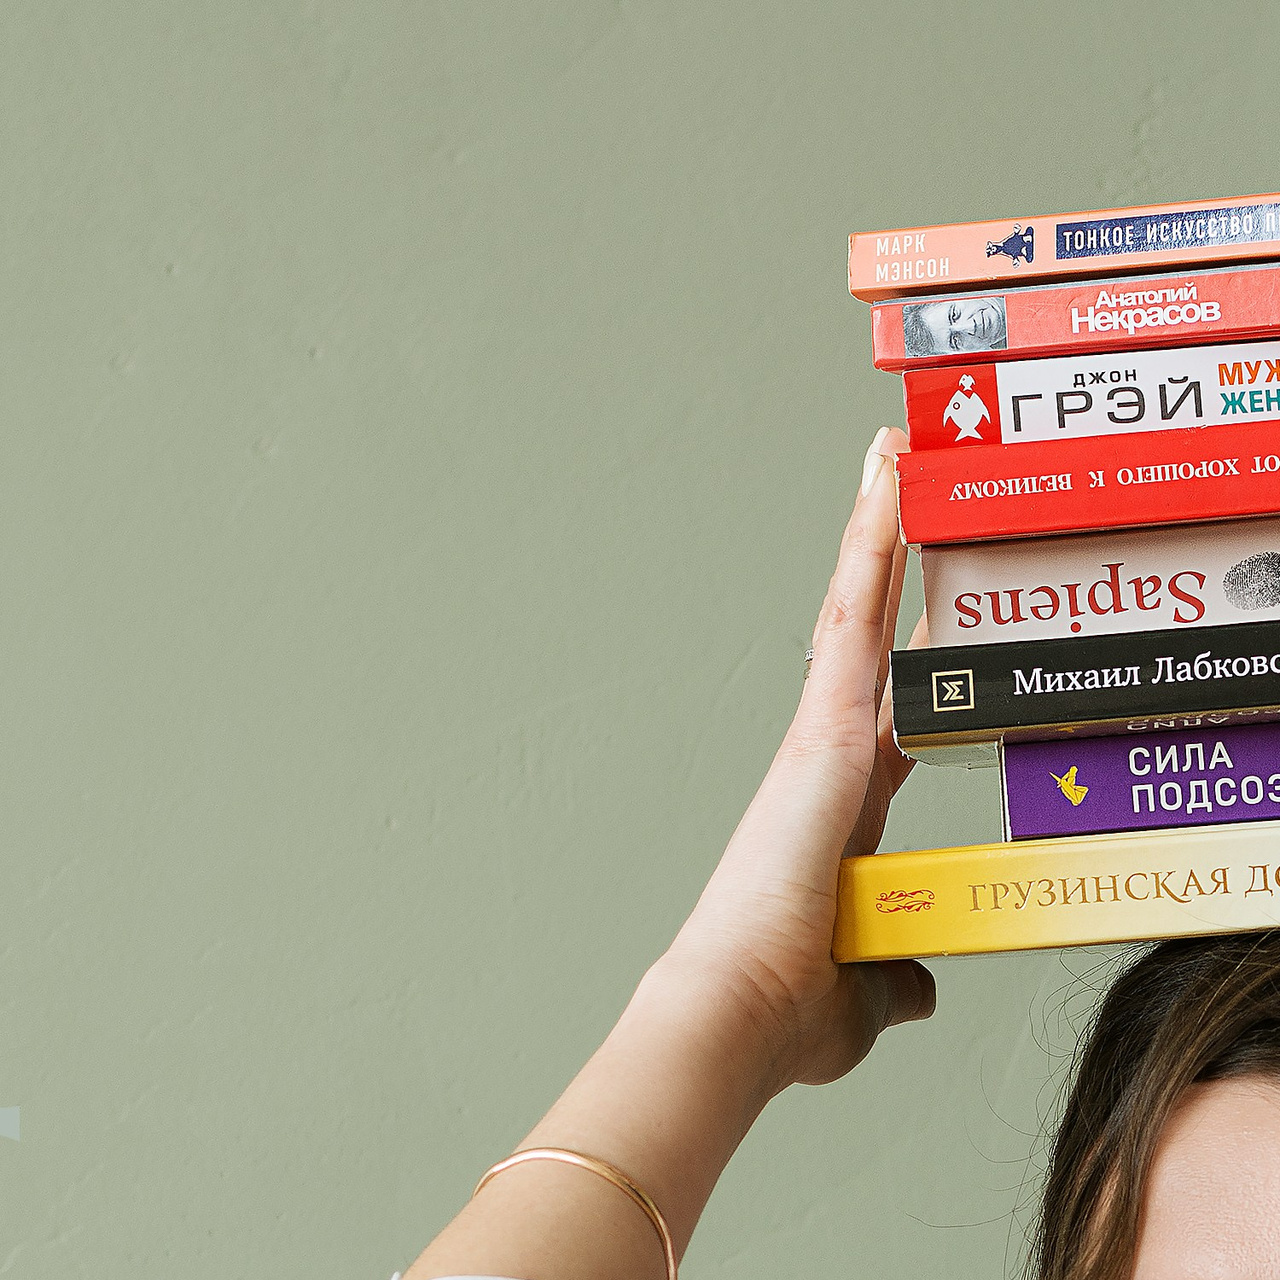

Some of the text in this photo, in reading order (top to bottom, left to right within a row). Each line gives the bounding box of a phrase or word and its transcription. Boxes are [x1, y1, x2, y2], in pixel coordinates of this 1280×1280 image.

[876, 233, 926, 257] МАРК
[1063, 223, 1135, 252] ТОНКОЕ
[1146, 214, 1253, 242] ИСКУССТВО
[875, 258, 950, 283] МЭНСОН
[1095, 282, 1198, 309] Анатолий
[1072, 299, 1221, 335] Некрасов
[1073, 369, 1138, 389] ДЖОН
[1011, 376, 1203, 433] ГРЭЙ
[949, 455, 1280, 501] ОТ ХОРОШЕГО К ВЕЛИКОМУ
[954, 562, 1207, 633] Sapiens
[1012, 666, 1142, 696] Михаил
[1128, 741, 1233, 777] СИЛА
[968, 866, 1230, 912] ГРУЗИНСКАЯ
